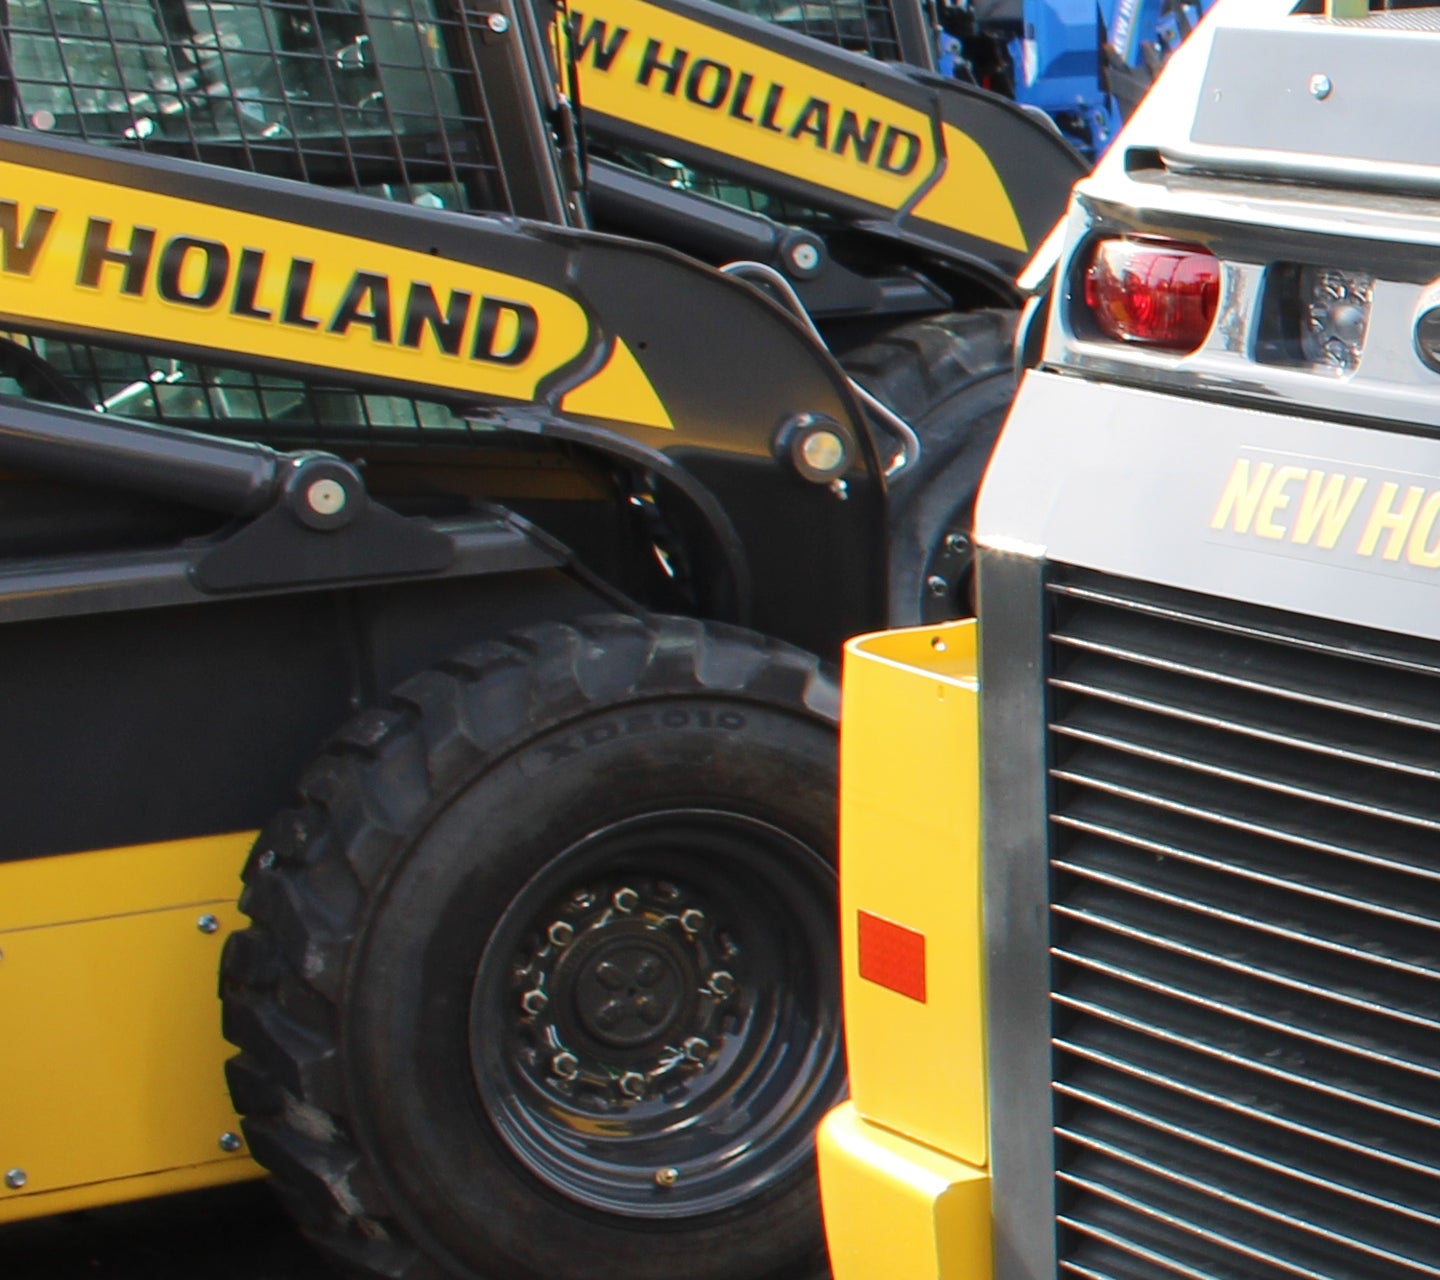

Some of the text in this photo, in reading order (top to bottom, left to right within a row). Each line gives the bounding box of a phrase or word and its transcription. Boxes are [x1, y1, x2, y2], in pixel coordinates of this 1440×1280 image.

[637, 37, 923, 177] HOLLAND
[75, 215, 540, 368] HOLLAND
[1209, 457, 1369, 550] NEW
